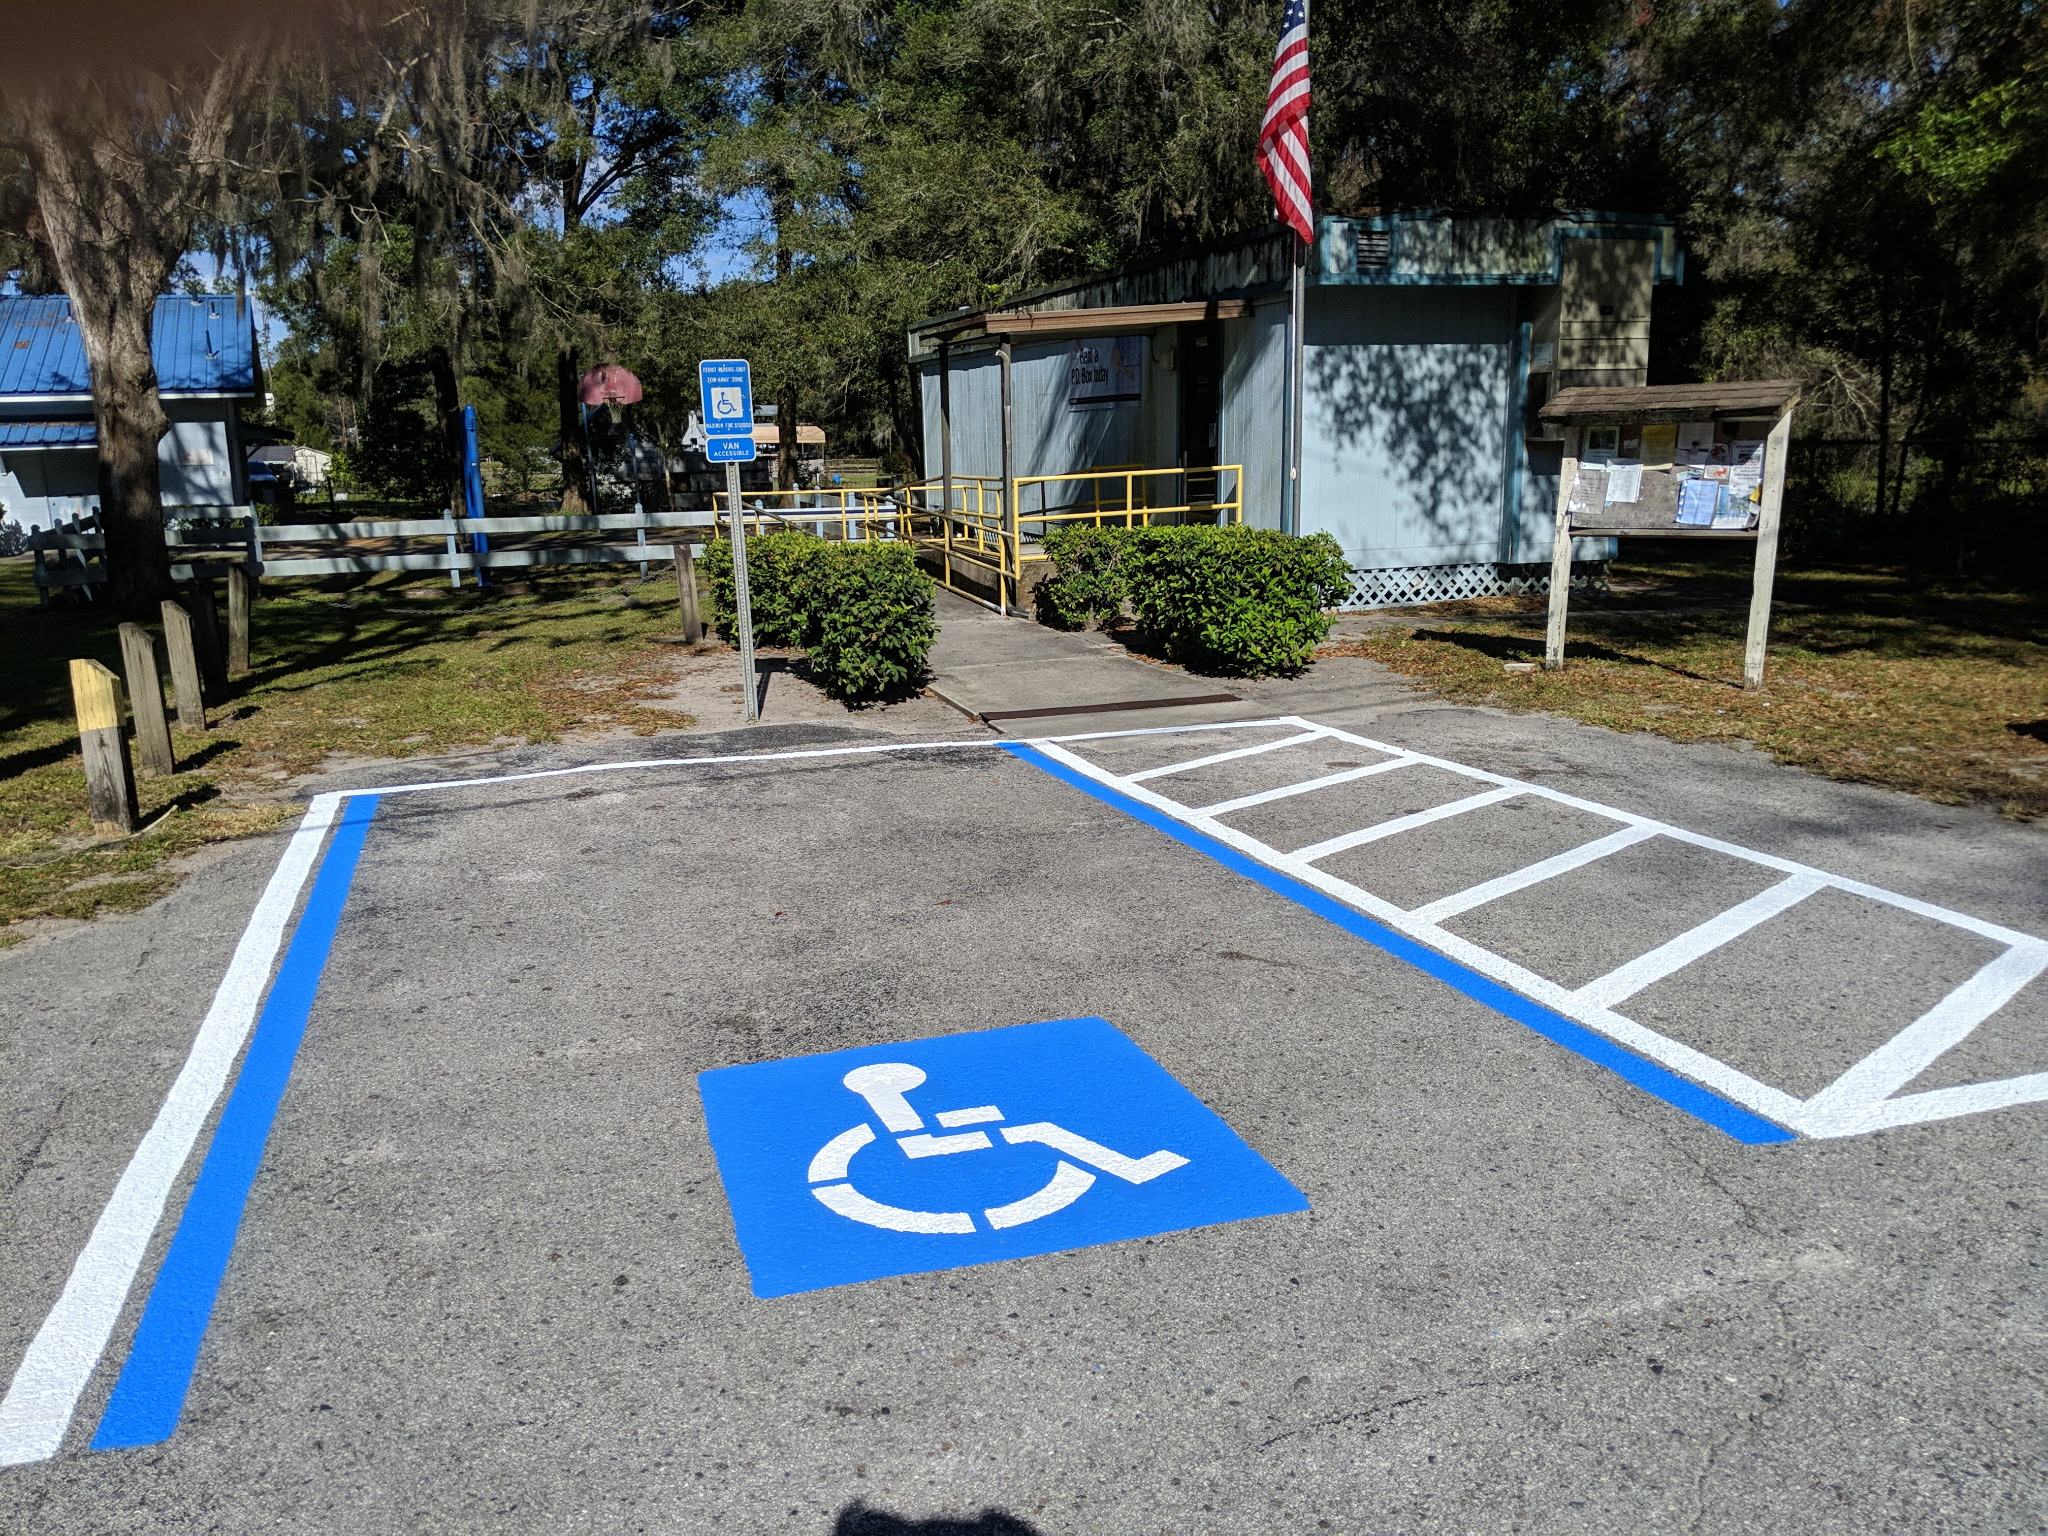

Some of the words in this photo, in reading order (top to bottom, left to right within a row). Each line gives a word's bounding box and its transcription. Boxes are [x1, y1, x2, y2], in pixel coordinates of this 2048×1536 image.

[1080, 347, 1092, 364] Rent
[1094, 349, 1099, 363] a
[1082, 367, 1092, 384] Box
[1094, 366, 1109, 385] today
[722, 442, 740, 450] VAN
